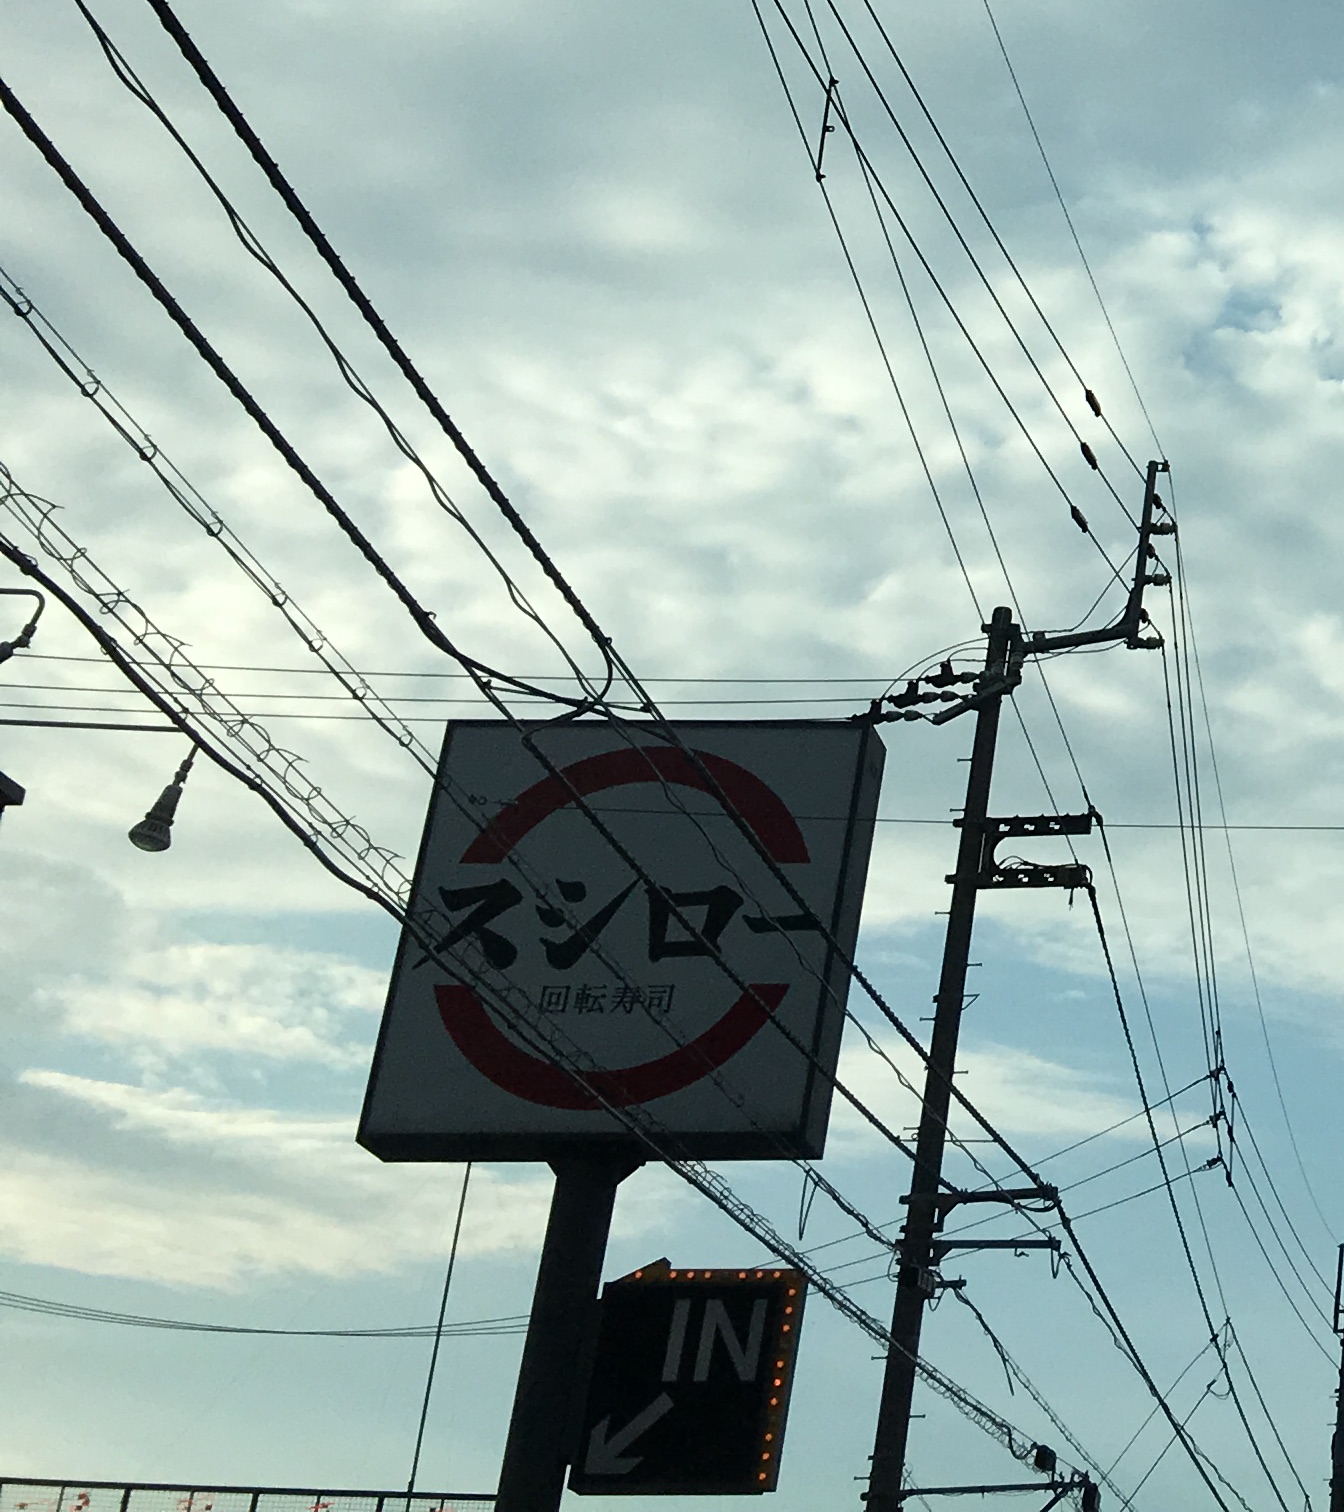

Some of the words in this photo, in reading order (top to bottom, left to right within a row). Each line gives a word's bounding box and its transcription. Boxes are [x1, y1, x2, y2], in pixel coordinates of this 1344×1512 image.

[412, 879, 822, 970] スシロー
[540, 984, 675, 1014] 回転寿司
[662, 1299, 768, 1381] IN
